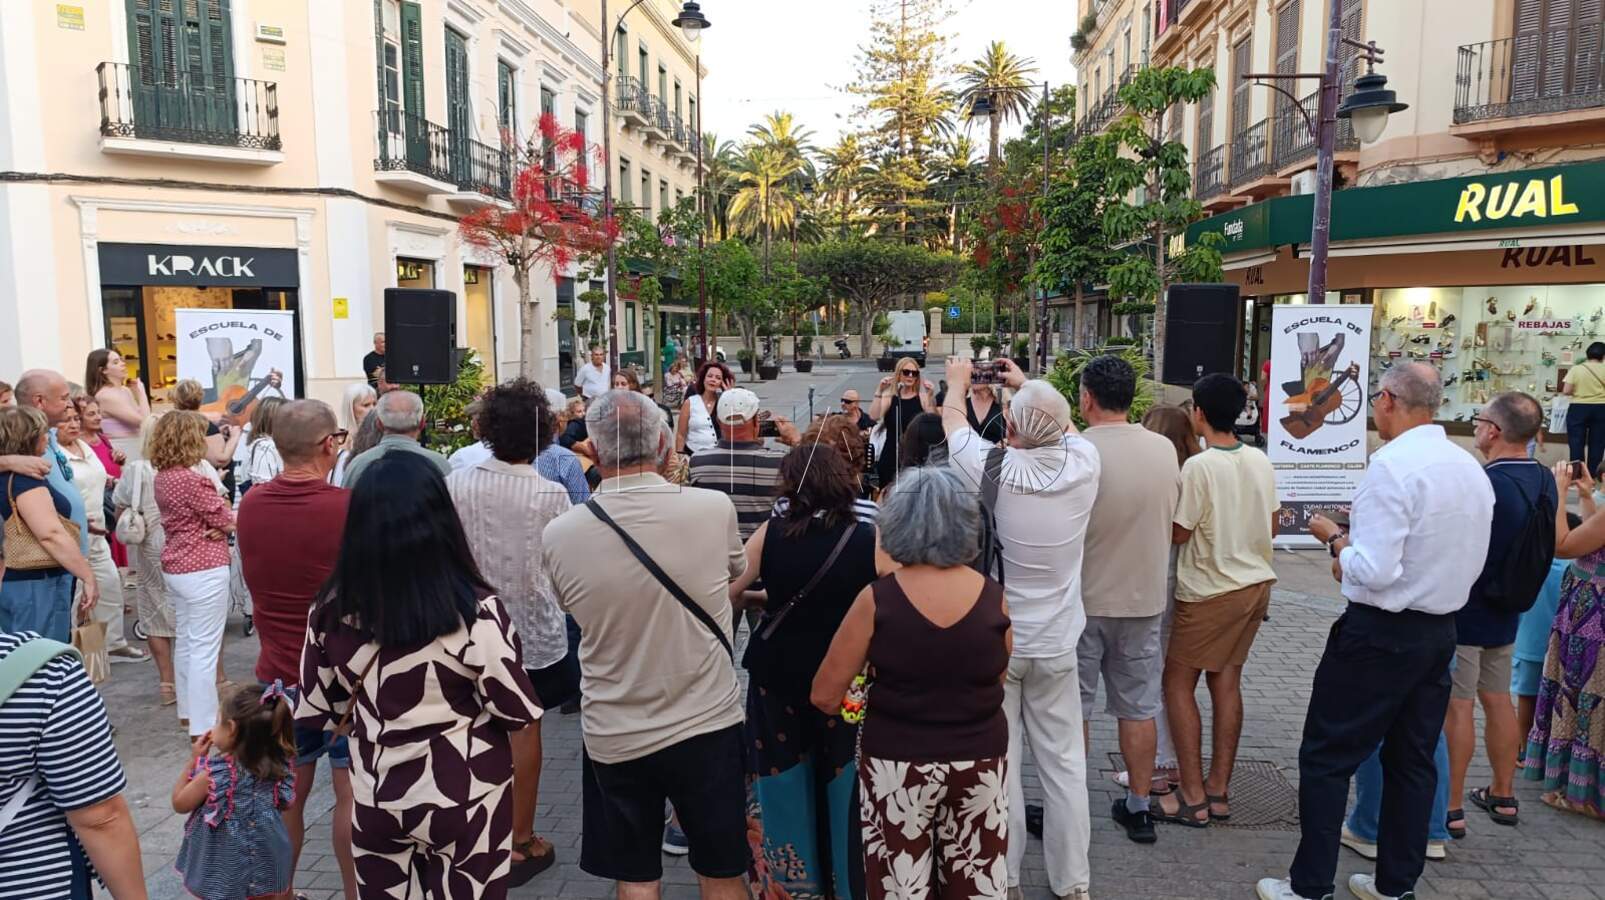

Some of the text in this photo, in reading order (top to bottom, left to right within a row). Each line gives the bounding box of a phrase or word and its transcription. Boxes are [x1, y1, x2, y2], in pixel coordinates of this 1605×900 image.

[1453, 174, 1579, 222] RUAL
[1224, 218, 1244, 236] Fundada
[1498, 239, 1521, 247] RUAL
[147, 254, 255, 277] KRACK
[1501, 245, 1596, 268] RUAL
[1245, 266, 1264, 285] RUAL
[189, 321, 284, 341] ESCUELA DE
[1283, 316, 1363, 335] ESCUELA DE
[1518, 321, 1572, 329] REBAJAS
[1280, 439, 1360, 455] FLAMENCO
